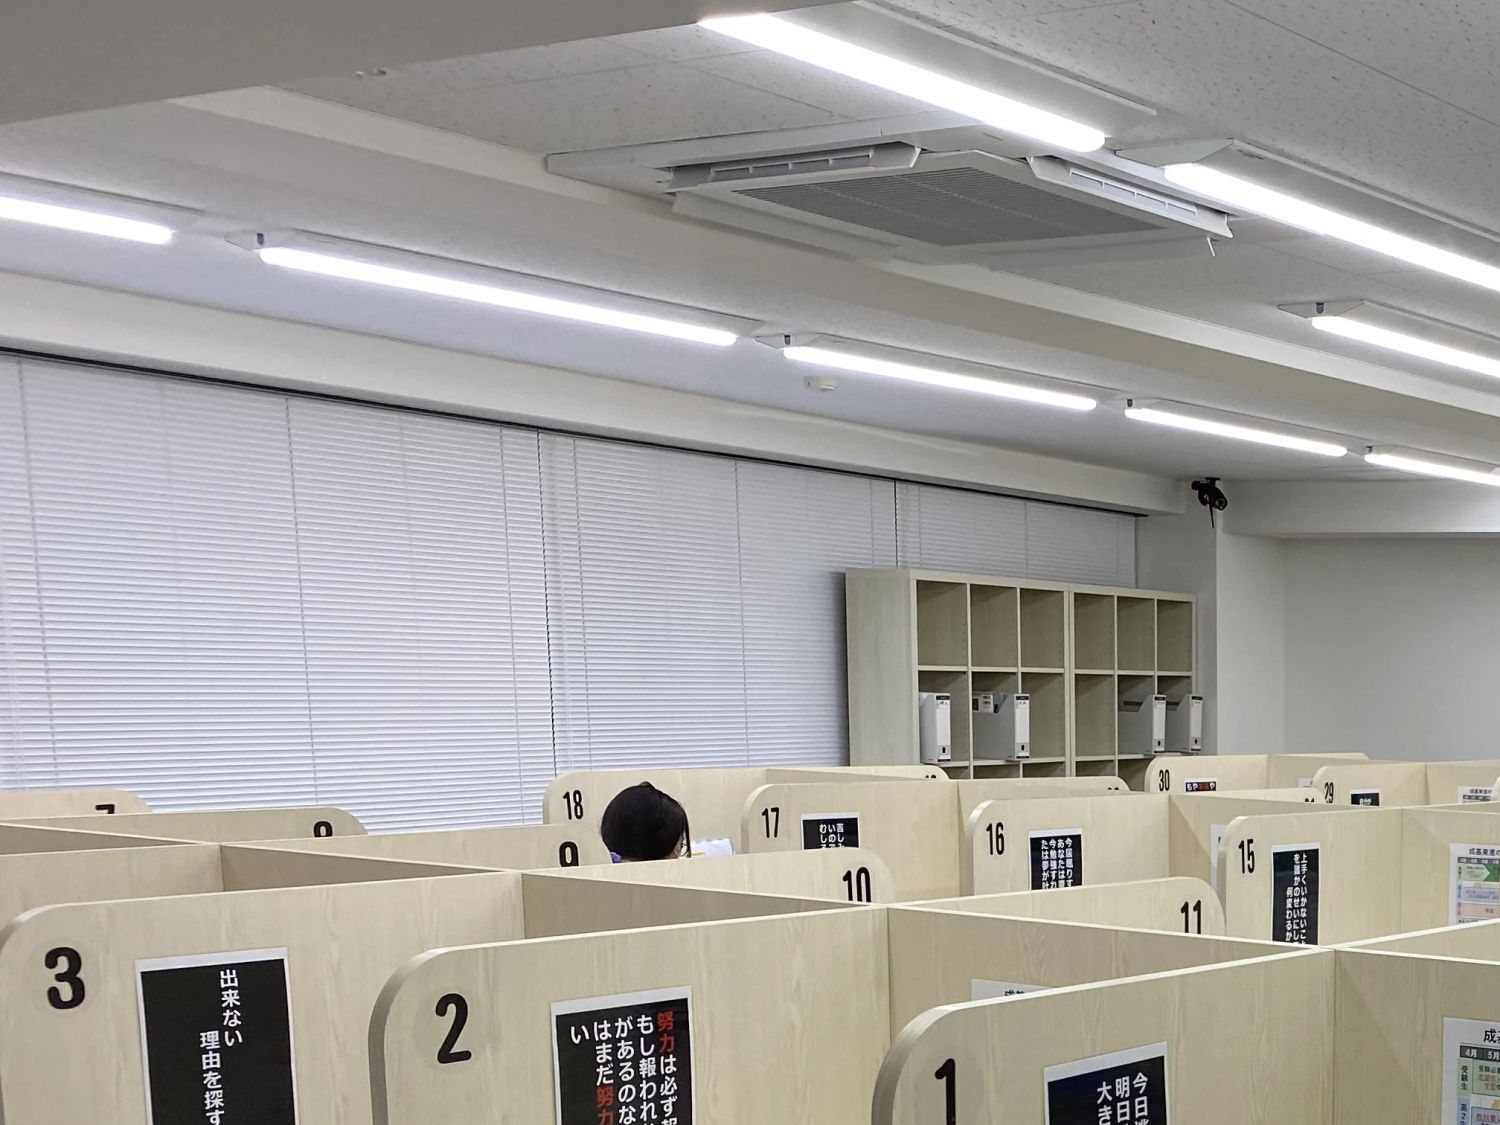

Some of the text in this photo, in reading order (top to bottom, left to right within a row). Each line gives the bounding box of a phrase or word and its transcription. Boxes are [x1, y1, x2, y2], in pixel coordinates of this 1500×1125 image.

[1158, 769, 1170, 791] 30
[1324, 782, 1335, 804] 29
[562, 789, 584, 821] 18
[761, 807, 780, 839] 17
[986, 821, 1005, 856] 16
[1238, 839, 1255, 874] 15
[842, 866, 872, 902] 10
[1180, 900, 1201, 934] 11
[44, 946, 86, 1010] 3
[219, 968, 243, 1047] 出来ない
[435, 993, 472, 1064] 2
[570, 1025, 590, 1044] い
[1465, 1048, 1477, 1058] 4月
[1487, 1051, 1500, 1060] 5月
